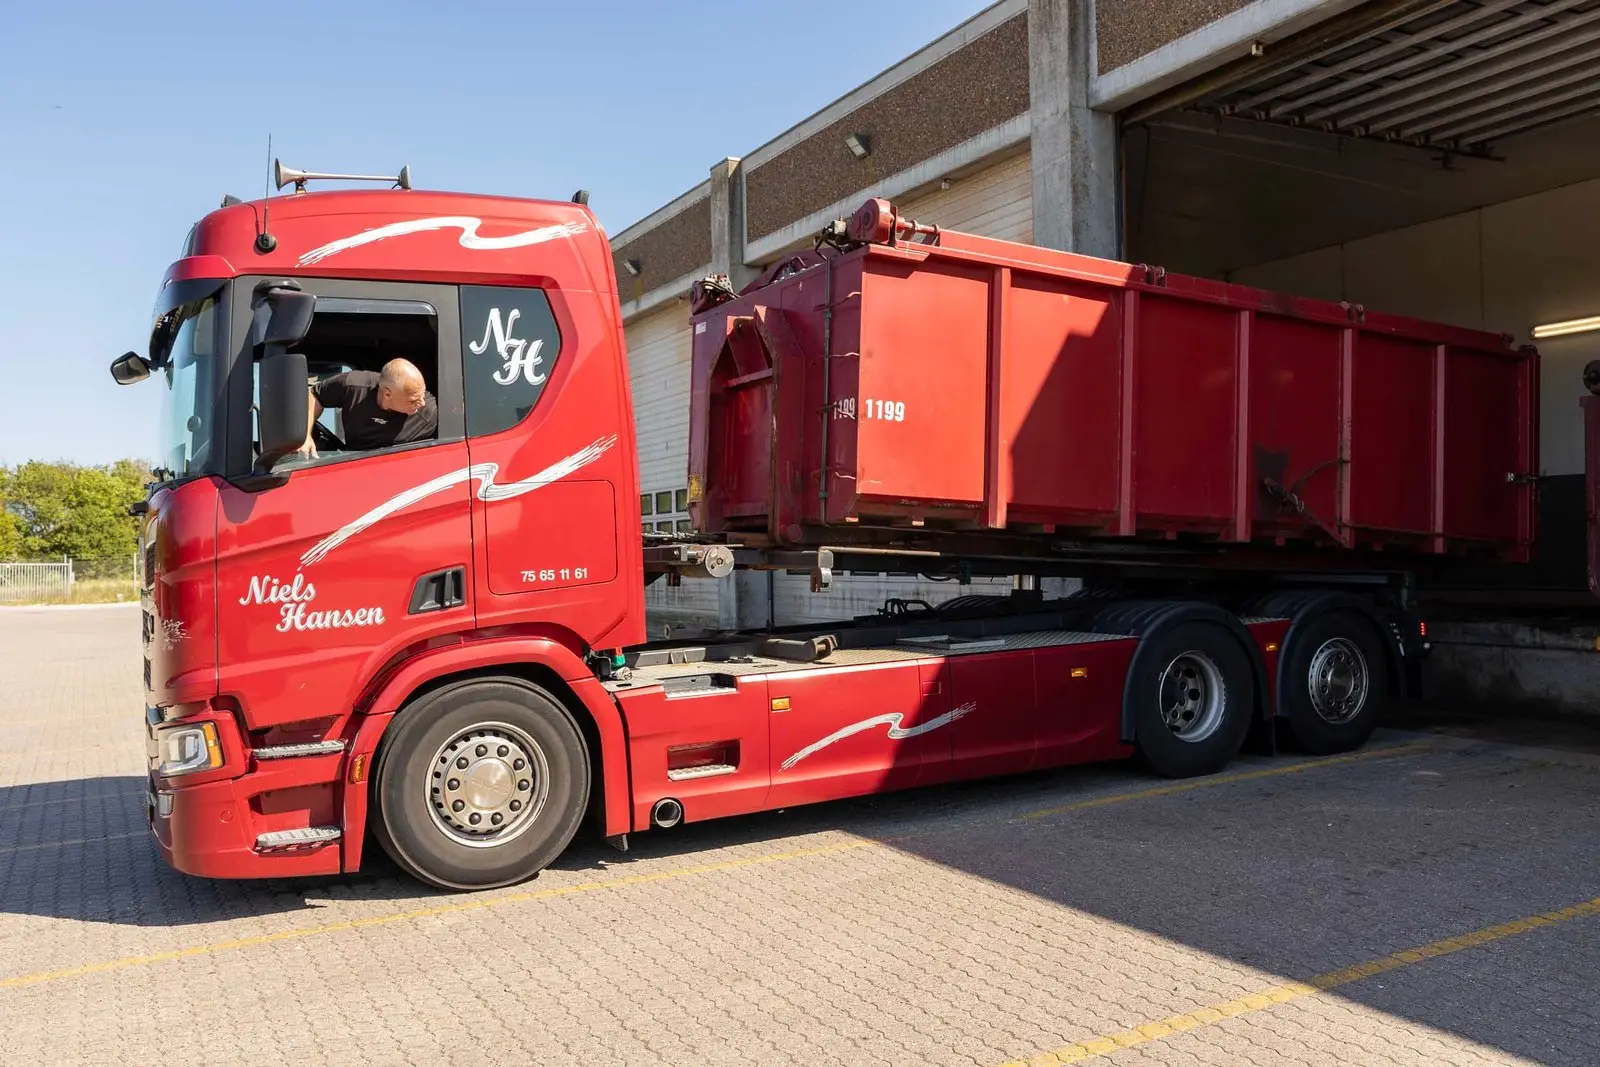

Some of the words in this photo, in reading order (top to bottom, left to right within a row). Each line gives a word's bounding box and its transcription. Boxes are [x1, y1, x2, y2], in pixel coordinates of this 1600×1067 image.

[865, 398, 905, 422] 1199
[238, 572, 317, 606] Niels
[521, 570, 536, 583] 75
[539, 569, 555, 582] 65
[559, 568, 570, 581] 11
[574, 567, 588, 580] 61
[275, 601, 386, 633] Hansen
